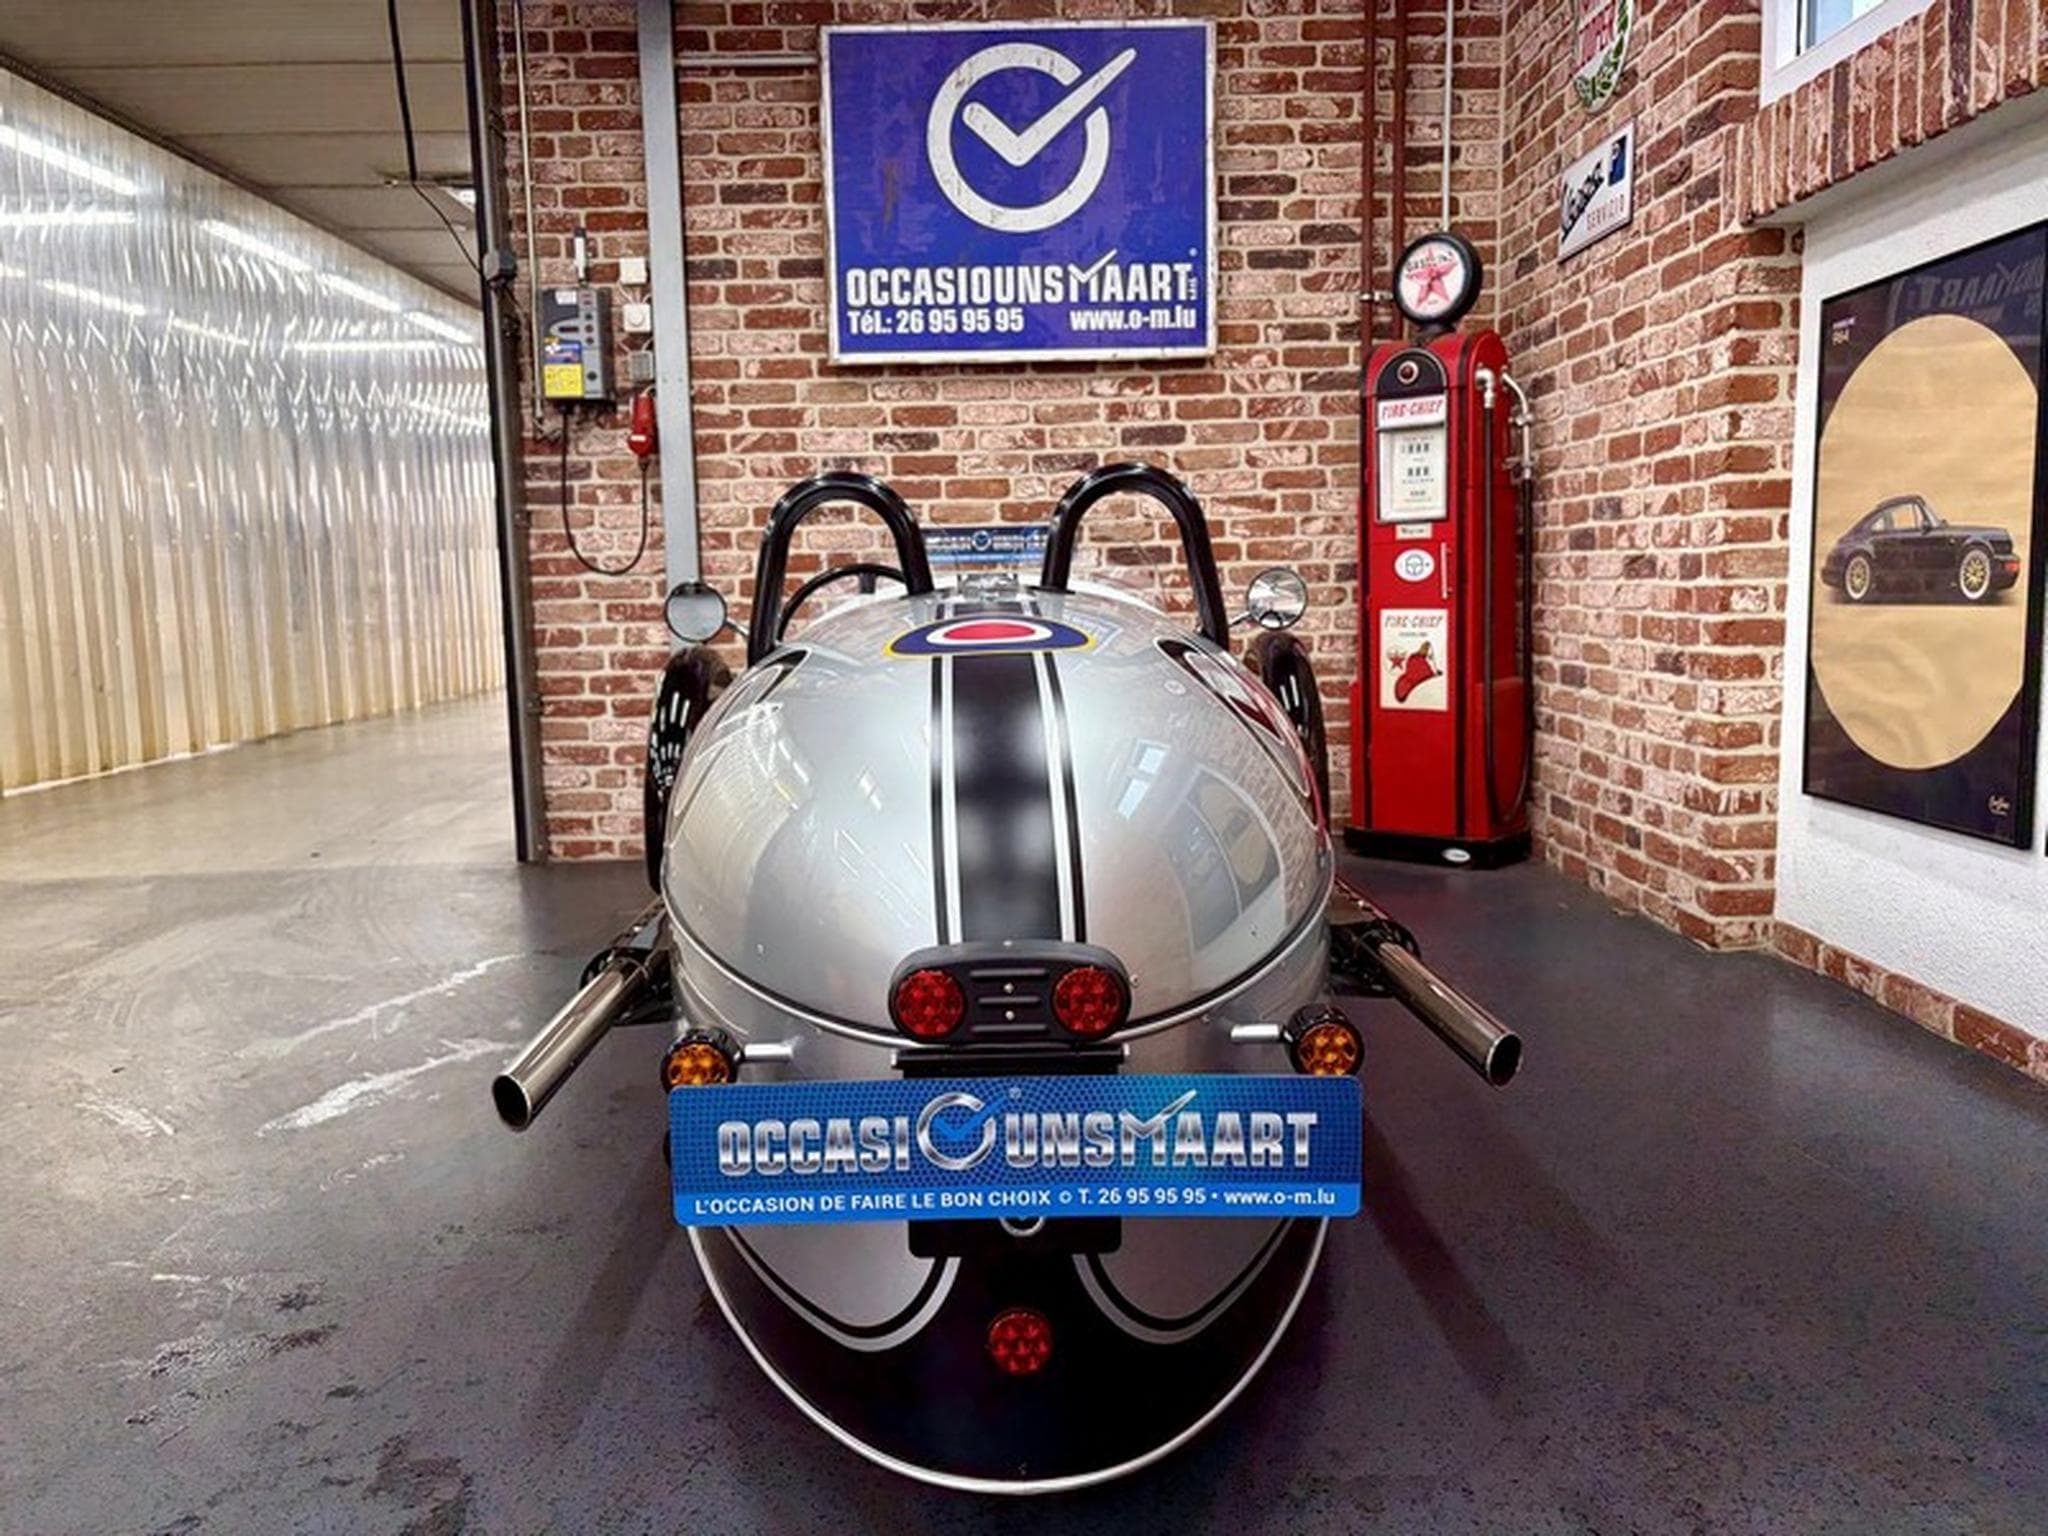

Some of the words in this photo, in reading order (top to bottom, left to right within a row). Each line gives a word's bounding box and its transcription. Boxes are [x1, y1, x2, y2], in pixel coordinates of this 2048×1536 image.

[896, 310, 924, 334] 26
[929, 309, 957, 334] 95
[961, 308, 991, 333] 95
[995, 308, 1024, 332] 95
[1069, 304, 1197, 331] www.o-m.lu
[695, 1197, 815, 1215] L'OCCASION
[823, 1196, 846, 1211] DE
[851, 1194, 906, 1210] FAIRE
[912, 1193, 934, 1209] LE
[941, 1192, 983, 1208] BON
[988, 1191, 1051, 1206] CHOIX
[1078, 1188, 1093, 1204] T.
[1099, 1188, 1121, 1204] 26
[1127, 1188, 1149, 1204] 95
[1155, 1188, 1177, 1204] 95
[1183, 1187, 1206, 1203] 95
[1223, 1187, 1336, 1205] www.o-m.lu
